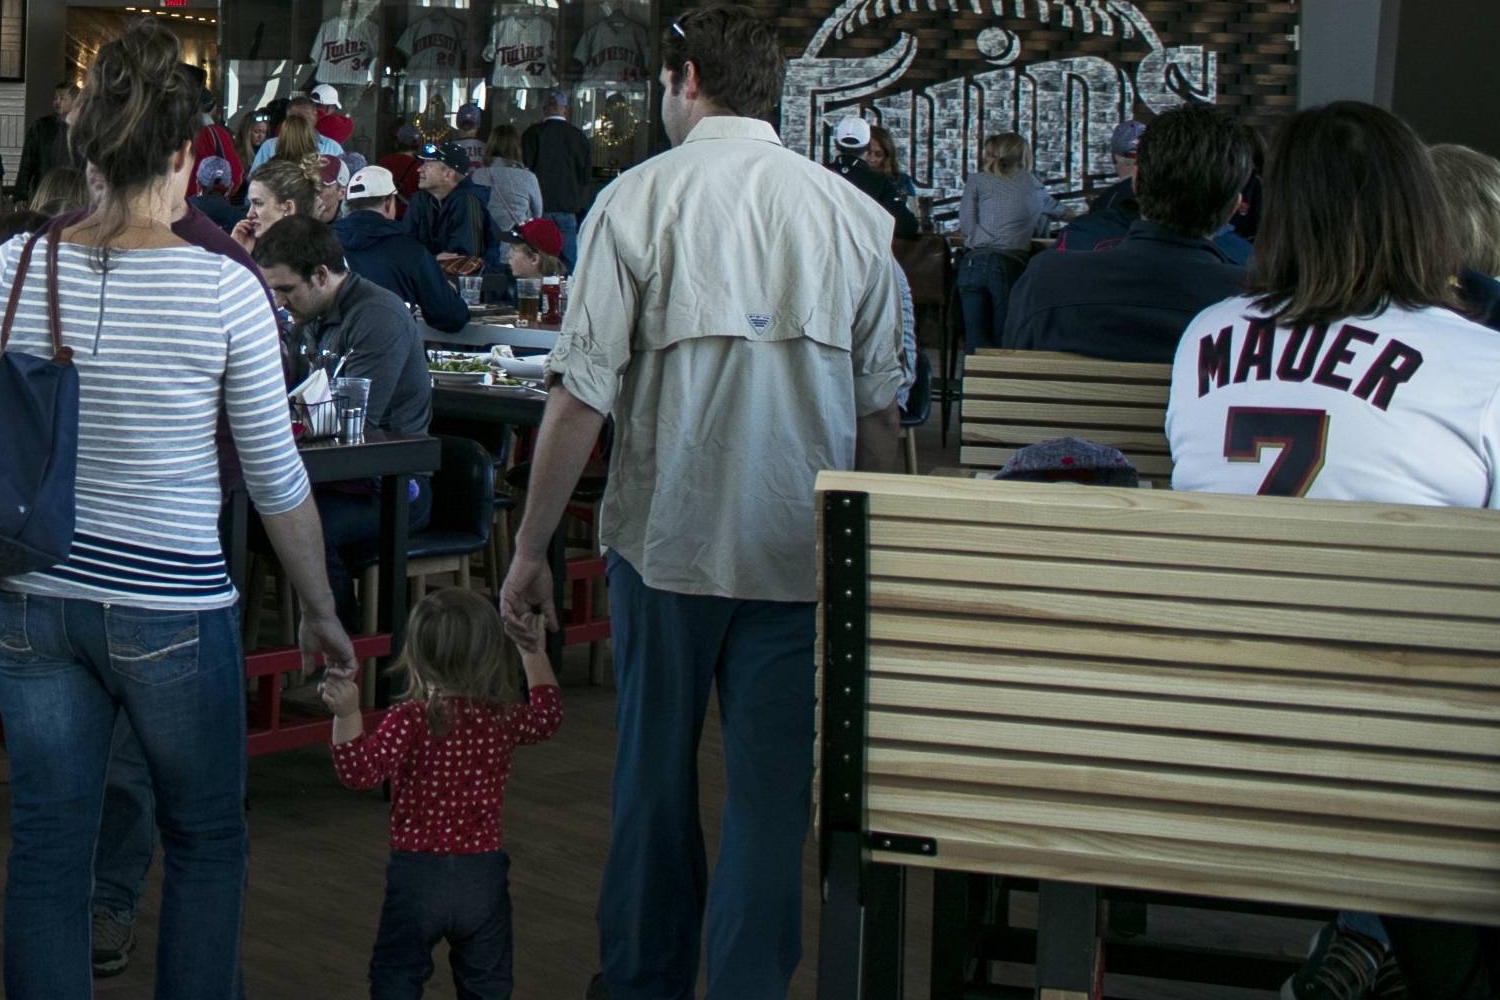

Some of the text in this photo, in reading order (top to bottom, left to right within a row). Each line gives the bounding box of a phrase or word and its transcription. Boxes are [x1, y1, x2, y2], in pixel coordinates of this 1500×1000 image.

[322, 38, 368, 64] Twins
[412, 33, 458, 56] MINNESOTA
[496, 44, 544, 67] Twins
[525, 62, 546, 76] 47
[1198, 318, 1424, 412] MAUER
[1222, 406, 1330, 498] 7
